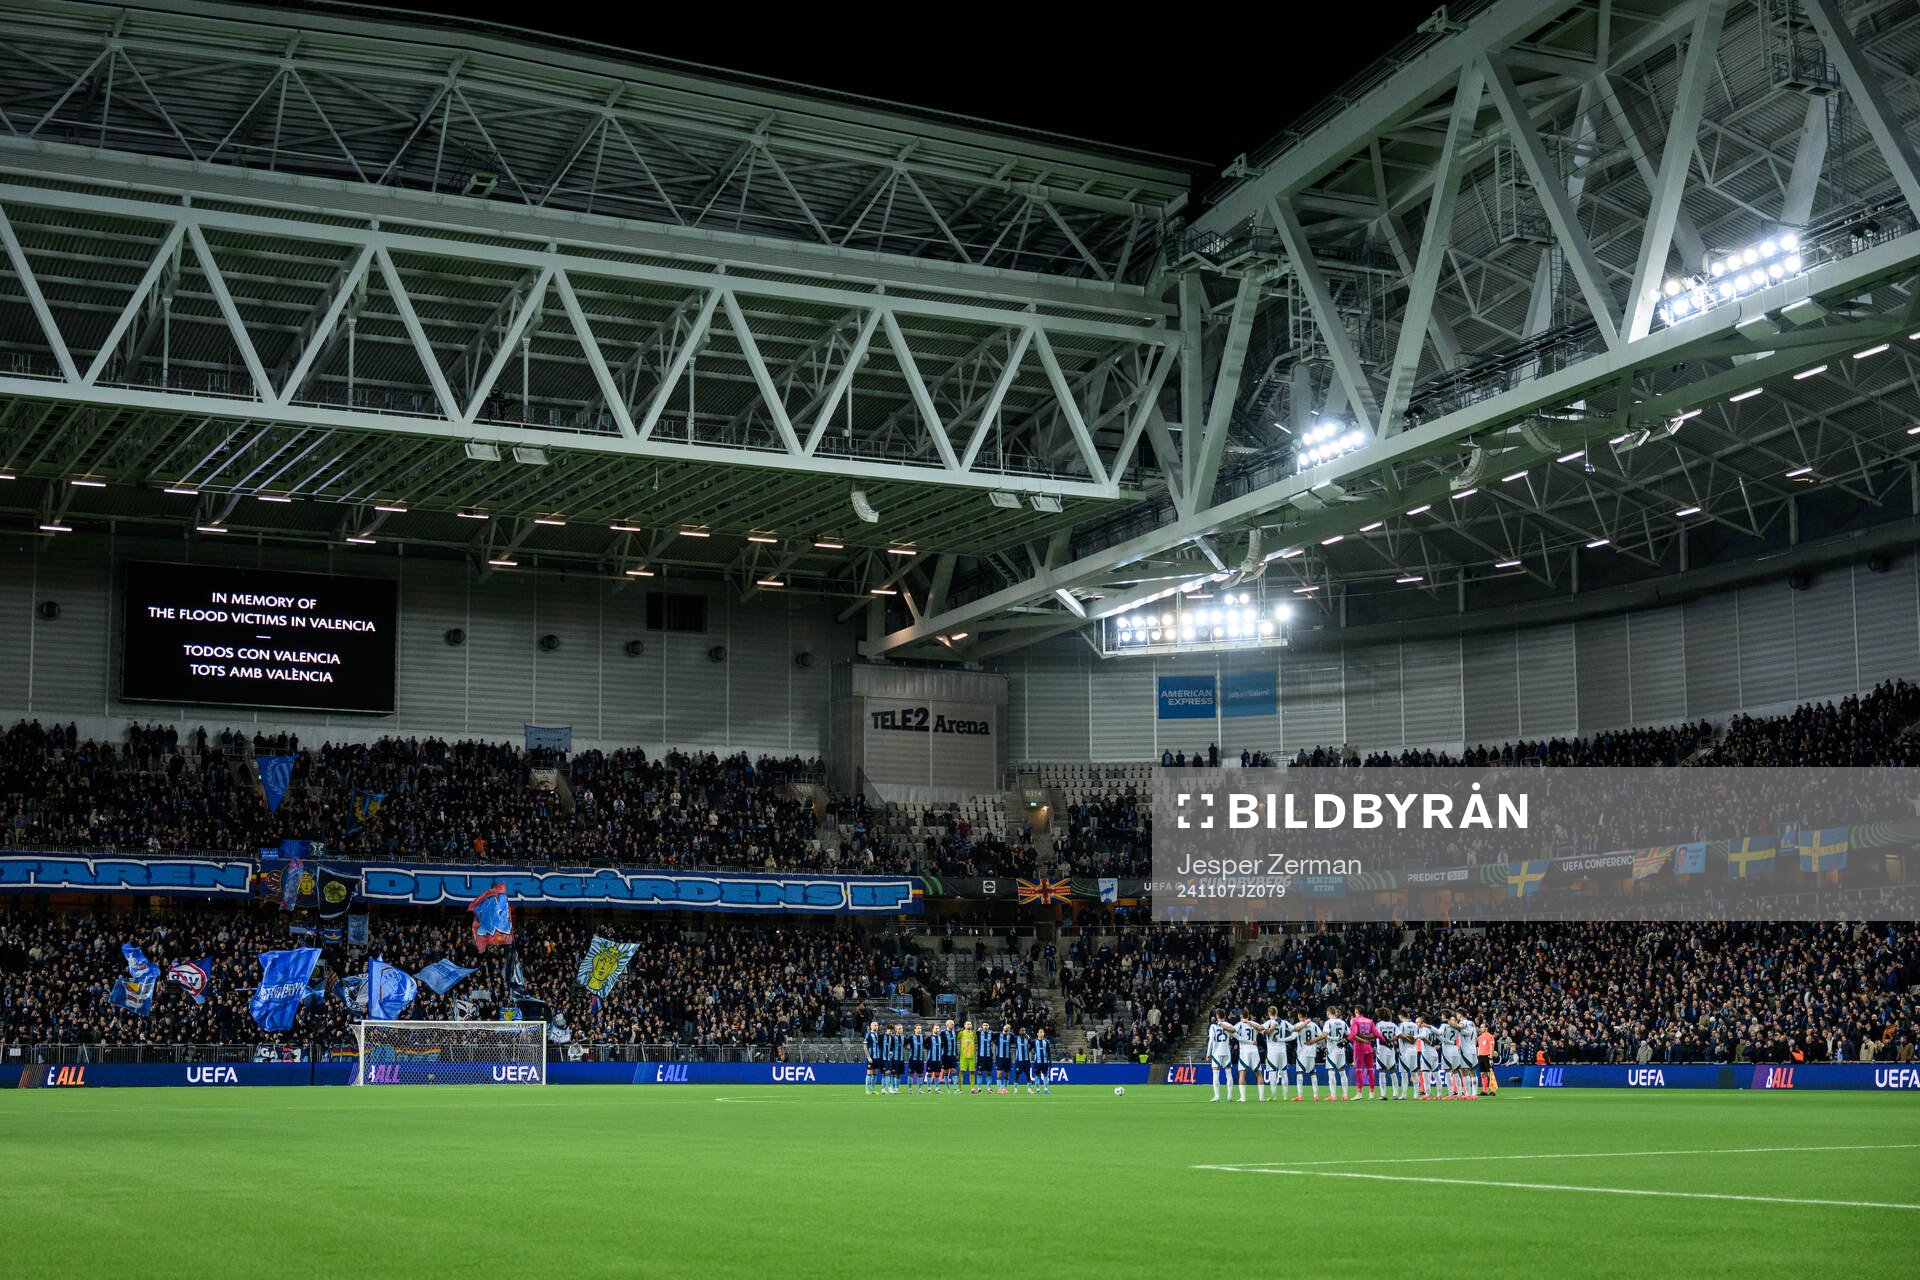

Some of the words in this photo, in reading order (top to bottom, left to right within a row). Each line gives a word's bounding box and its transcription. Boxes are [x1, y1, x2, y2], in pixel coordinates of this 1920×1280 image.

[212, 592, 227, 604] IN
[231, 593, 294, 608] MEMORY
[298, 598, 317, 610] OF
[148, 606, 175, 619] THE
[179, 609, 228, 623] FLOOD
[231, 612, 287, 626] VICTIMS
[291, 616, 306, 627] IN
[309, 617, 376, 632] VALENCIA
[183, 644, 233, 659] TODOS
[237, 648, 270, 661] CON
[273, 650, 341, 665] VALENCIA
[190, 664, 225, 677] TOTS
[229, 666, 263, 679] AMB
[266, 668, 333, 683] VALÈNCIA
[1161, 689, 1213, 698] AMERICAN
[1168, 698, 1214, 706] EXPRESS
[871, 707, 930, 732] TELE2
[932, 714, 990, 735] Arena
[1563, 859, 1583, 871] UEFA
[1408, 872, 1446, 882] PREDICT
[362, 866, 848, 911] DJURGÅRDENS
[848, 880, 913, 911] IF
[1144, 882, 1172, 891] UEFA
[1216, 1029, 1227, 1042] 25
[1245, 1028, 1254, 1041] 31
[1305, 1030, 1312, 1040] 8
[186, 1066, 238, 1083] UEFA
[492, 1066, 539, 1081] UEFA
[772, 1066, 816, 1082] UEFA
[1628, 1069, 1664, 1086] UEFA
[1875, 1069, 1920, 1088] UEFA
